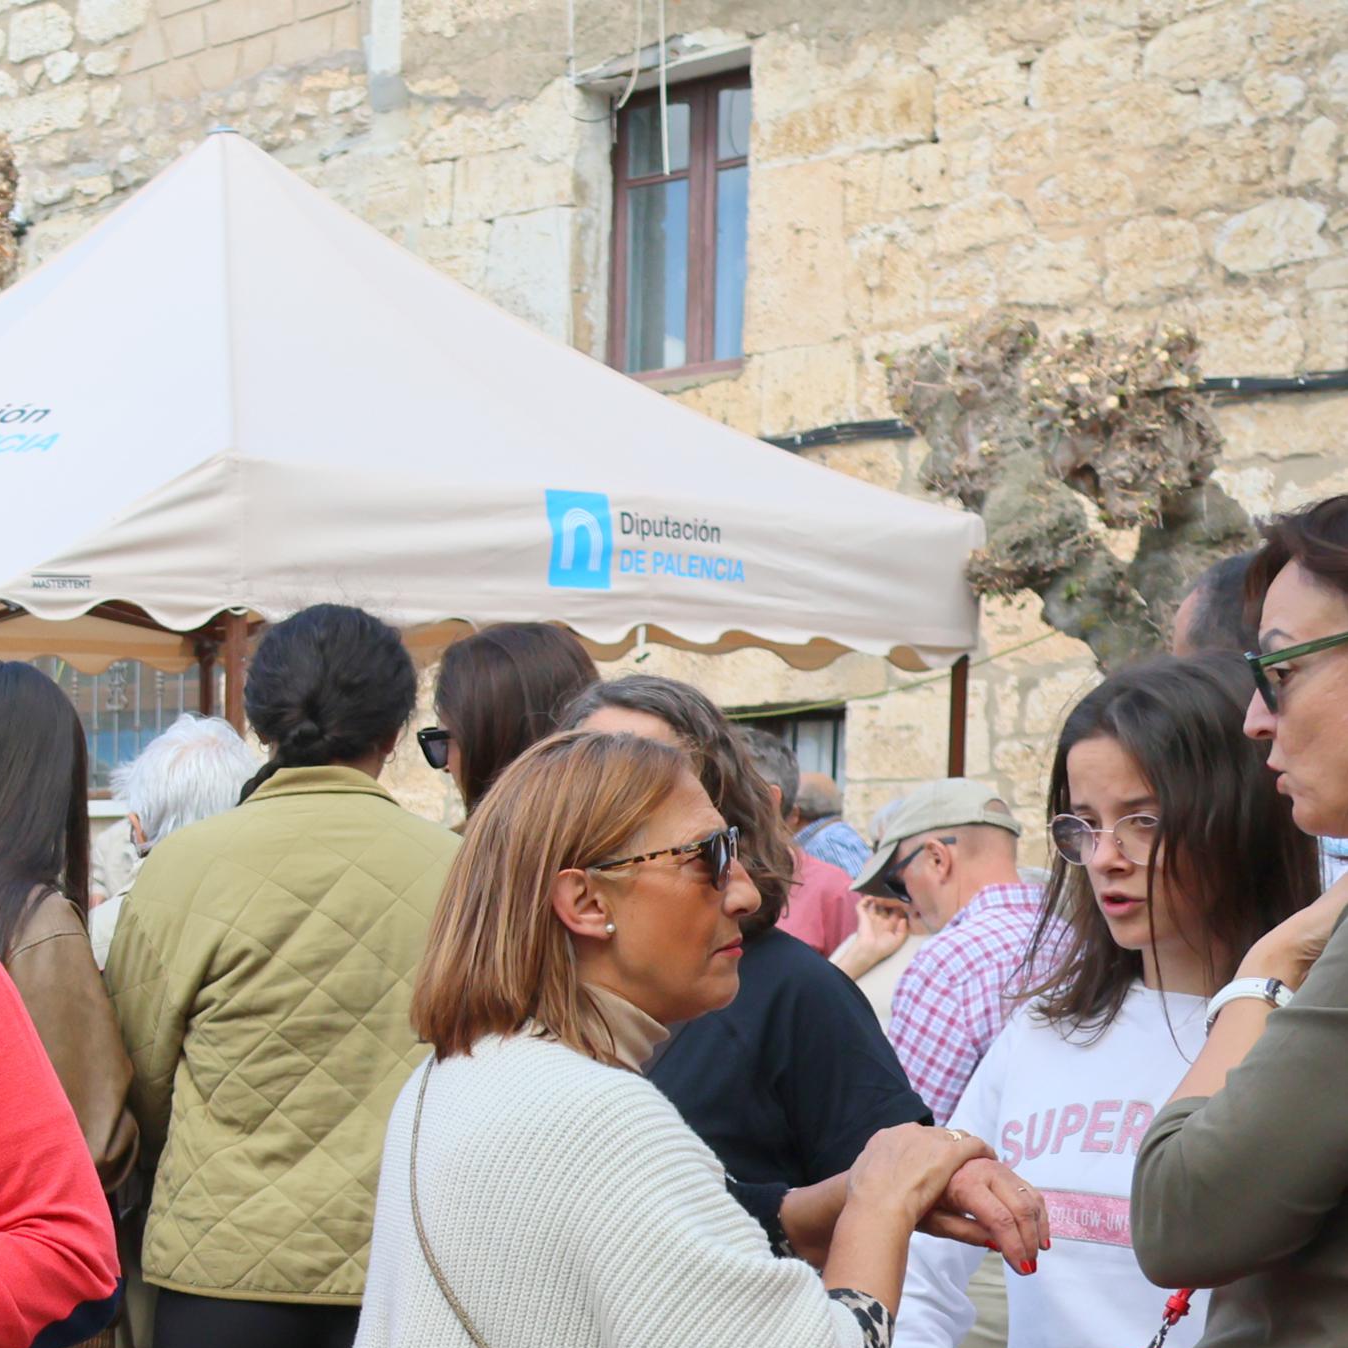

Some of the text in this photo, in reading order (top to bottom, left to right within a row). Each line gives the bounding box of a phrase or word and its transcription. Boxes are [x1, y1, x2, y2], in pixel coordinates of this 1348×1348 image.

[620, 511, 721, 543] Diputación
[619, 549, 745, 582] DE PALENCIA
[1001, 1099, 1155, 1170] SUPER
